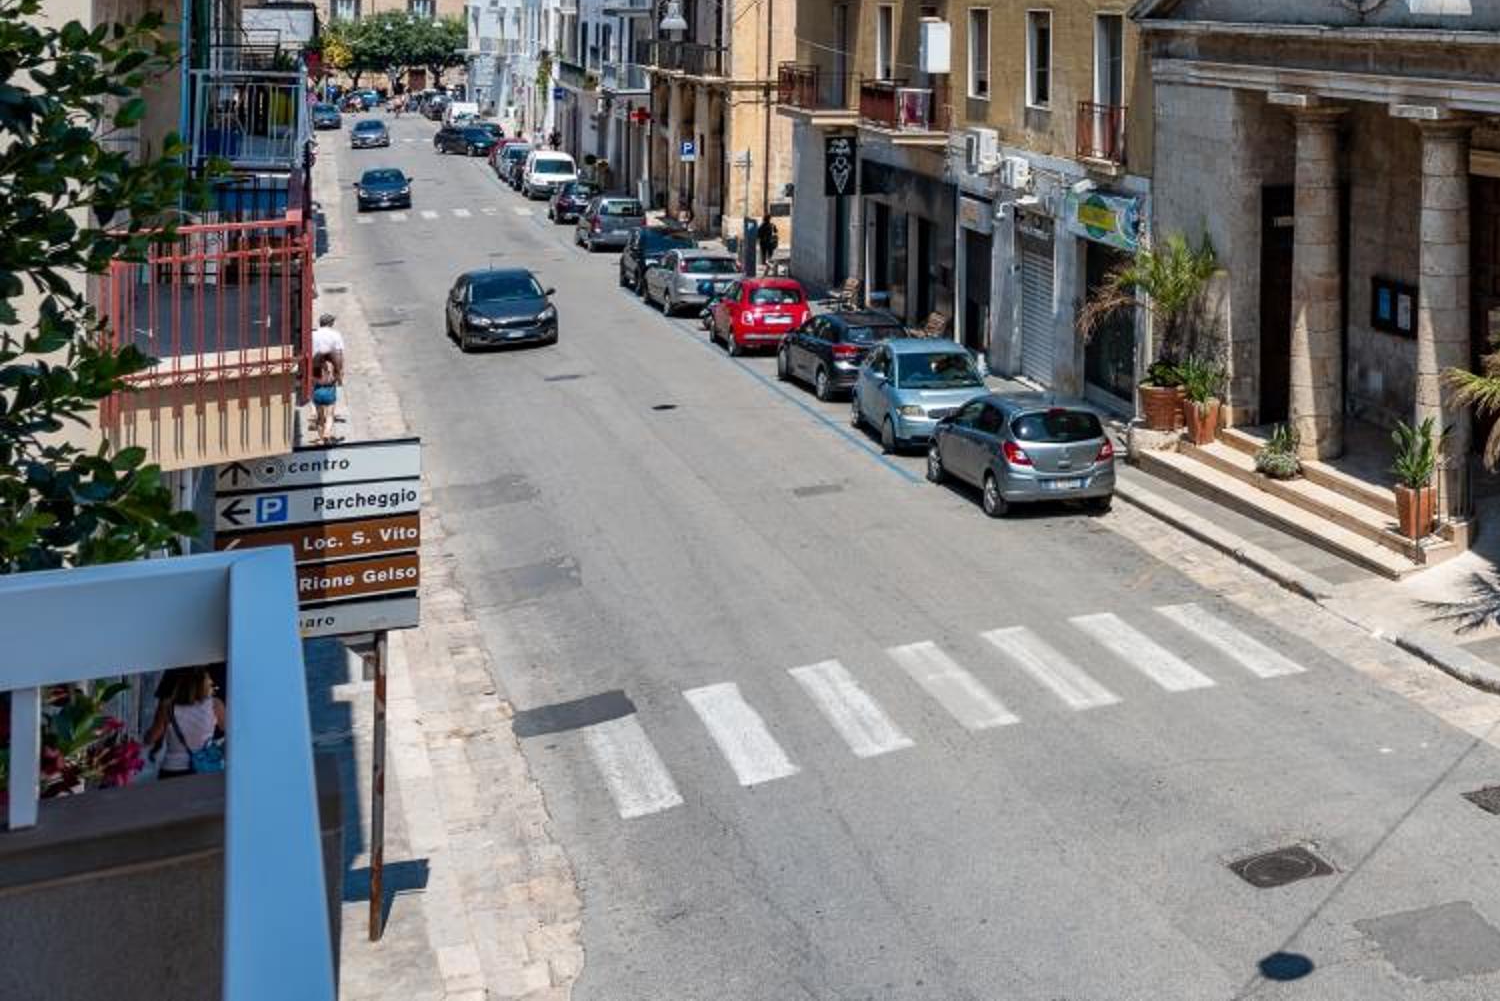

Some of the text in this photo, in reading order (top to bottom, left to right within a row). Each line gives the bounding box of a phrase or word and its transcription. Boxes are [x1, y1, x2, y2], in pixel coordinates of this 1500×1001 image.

[288, 458, 350, 474] centro
[261, 488, 417, 521] P Parcheggio
[303, 526, 418, 551] Loc. S. Vito
[299, 566, 417, 592] Rione Gelso
